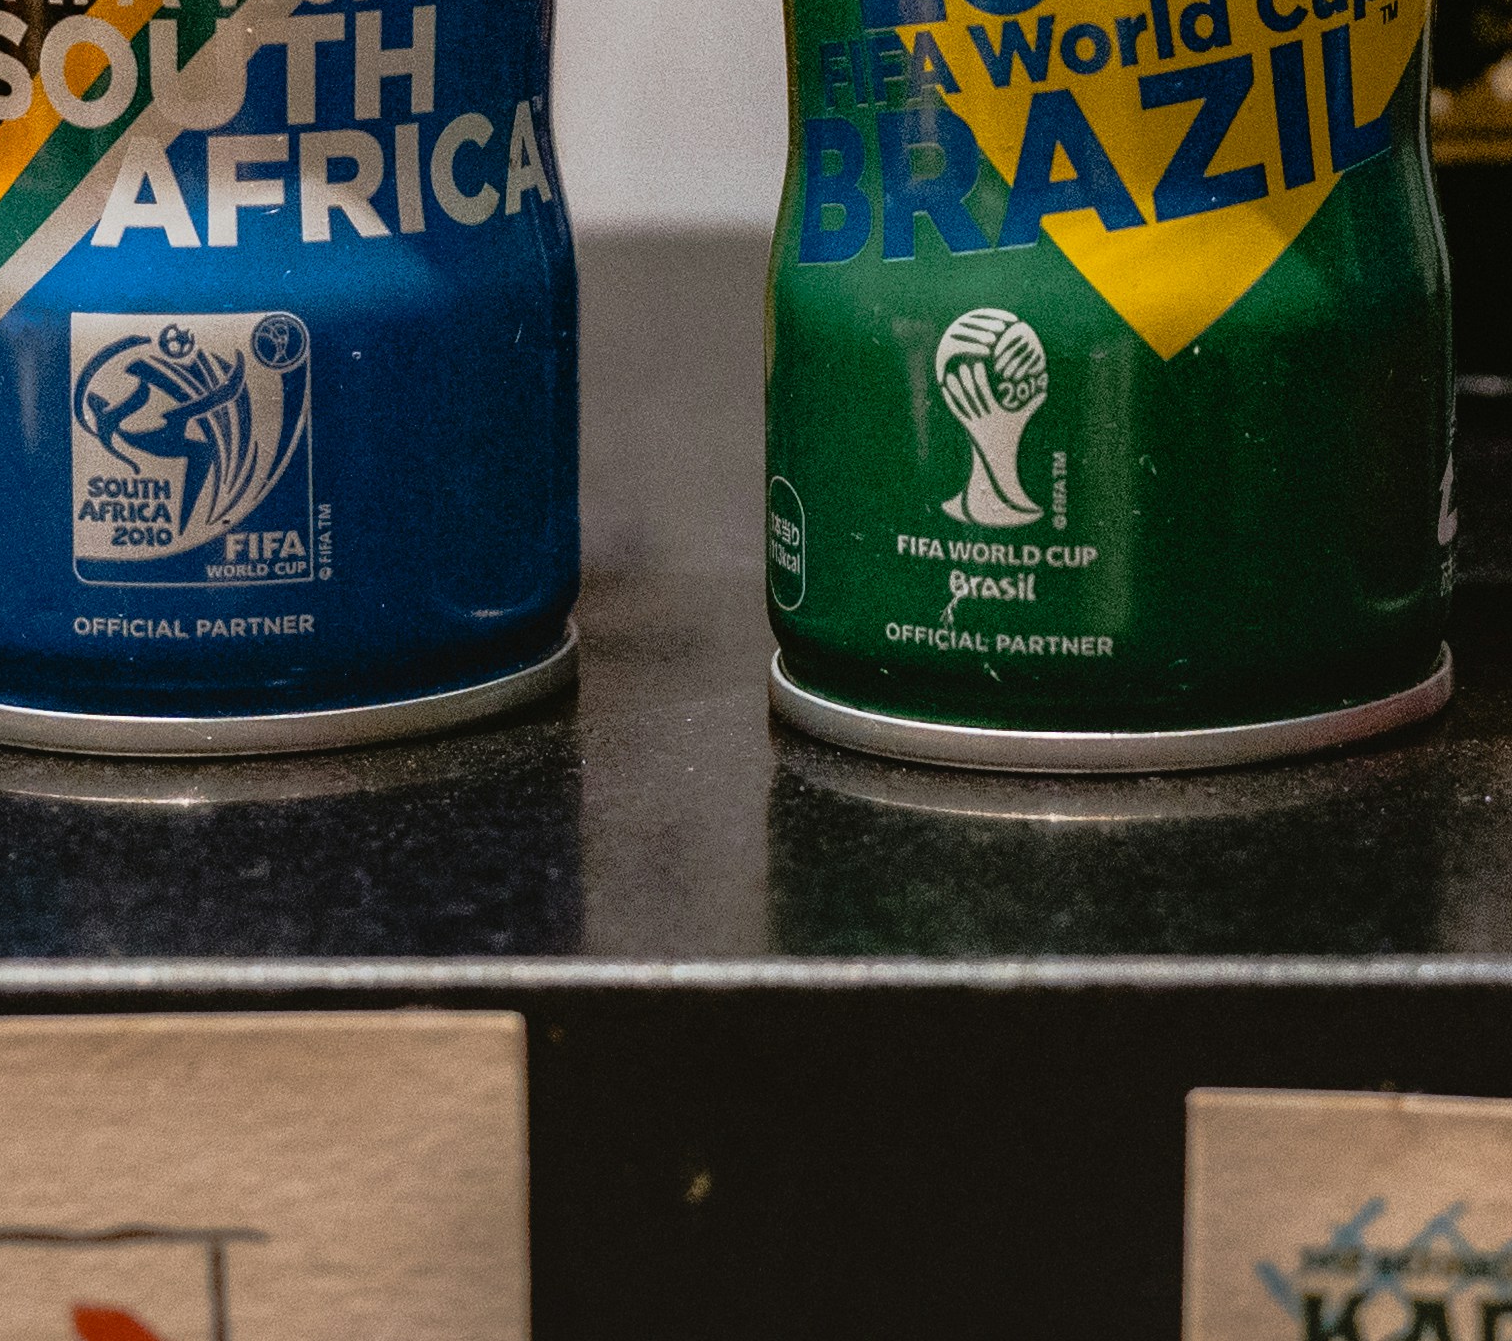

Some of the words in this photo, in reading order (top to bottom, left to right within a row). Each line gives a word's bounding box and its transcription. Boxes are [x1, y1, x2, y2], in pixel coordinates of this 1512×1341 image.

[818, 28, 962, 114] FIFA
[797, 22, 1395, 267] BRAZIL
[90, 99, 554, 248] AFRICA
[87, 476, 172, 500] SOUTH
[77, 499, 173, 524] AFRICA
[110, 525, 174, 547] 2010
[224, 530, 307, 562] FIFA
[896, 534, 946, 561] FIFA
[947, 539, 1041, 568] WORLD
[1045, 544, 1099, 568] CUP
[205, 563, 269, 580] WORLD
[274, 560, 308, 575] CUP
[949, 568, 1037, 602] Brasil
[73, 616, 190, 639] OFFICIAL
[196, 614, 316, 638] PARTNER
[885, 621, 989, 653] OFFICIAL
[994, 633, 1114, 657] PARTNER
